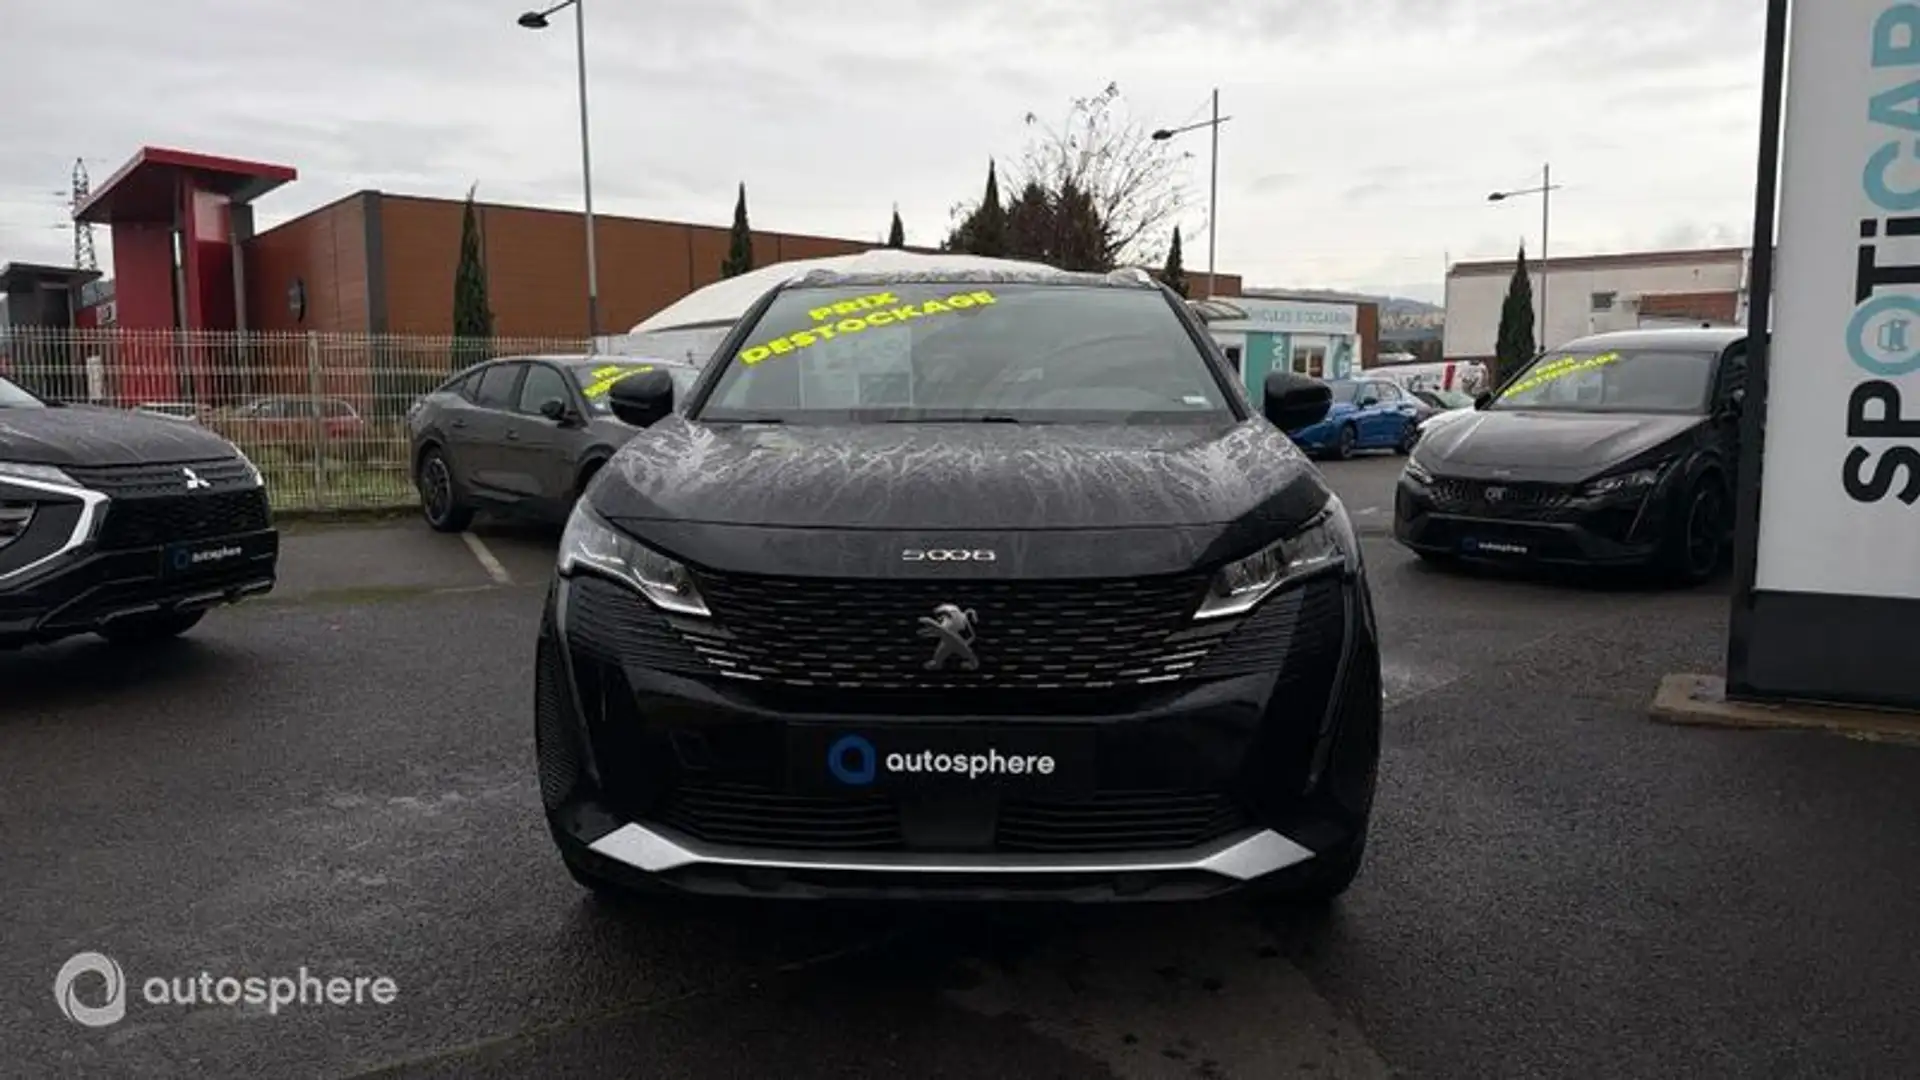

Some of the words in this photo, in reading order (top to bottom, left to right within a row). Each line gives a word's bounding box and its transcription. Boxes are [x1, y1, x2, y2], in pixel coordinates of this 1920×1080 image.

[808, 291, 898, 321] PRIX
[739, 290, 995, 366] DESTOCKAGE
[902, 549, 996, 561] 5008
[885, 748, 1056, 779] autosphere
